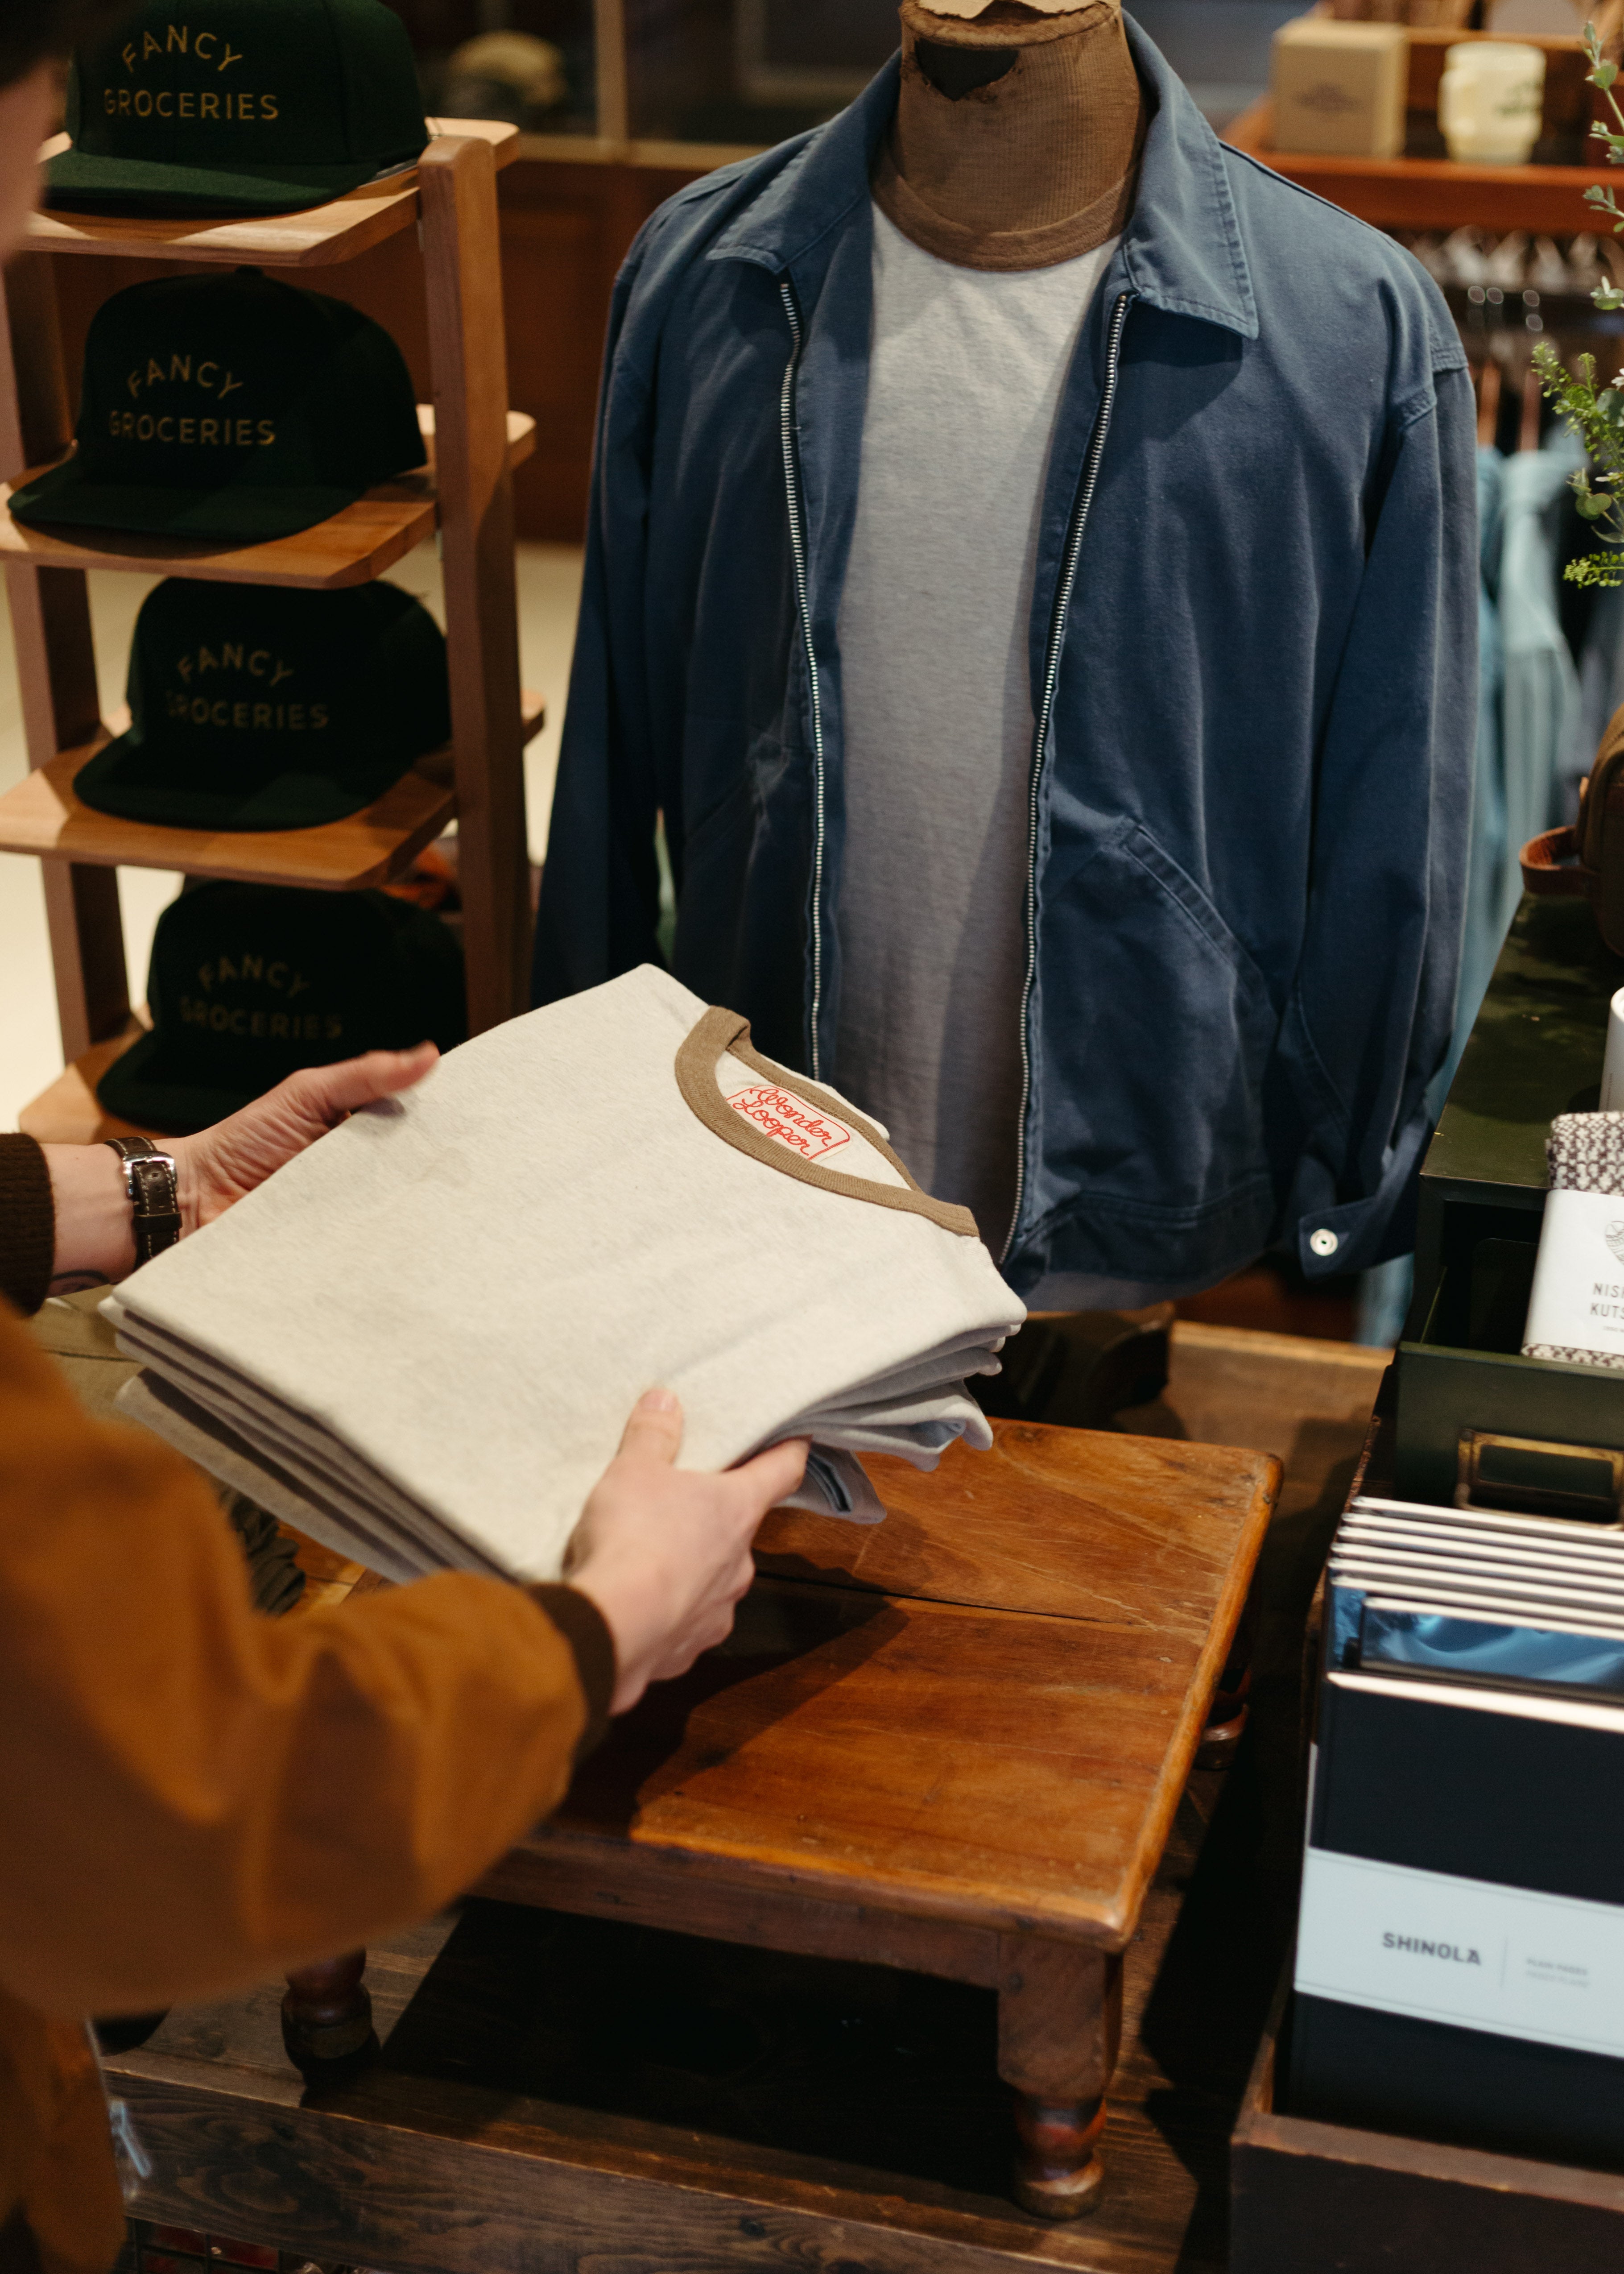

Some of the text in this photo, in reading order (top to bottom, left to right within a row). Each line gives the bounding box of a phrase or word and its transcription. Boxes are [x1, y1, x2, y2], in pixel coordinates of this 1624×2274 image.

[122, 25, 242, 73] FANCY
[104, 88, 279, 120] GROCERIES
[128, 354, 243, 399] FANCY
[109, 410, 275, 445] GROCERIES
[177, 642, 294, 688] FANCY
[198, 952, 313, 999] FANCY
[732, 1098, 812, 1156] Looper
[750, 1088, 832, 1147] Wonder
[1383, 1932, 1481, 1966] SHINOLA
